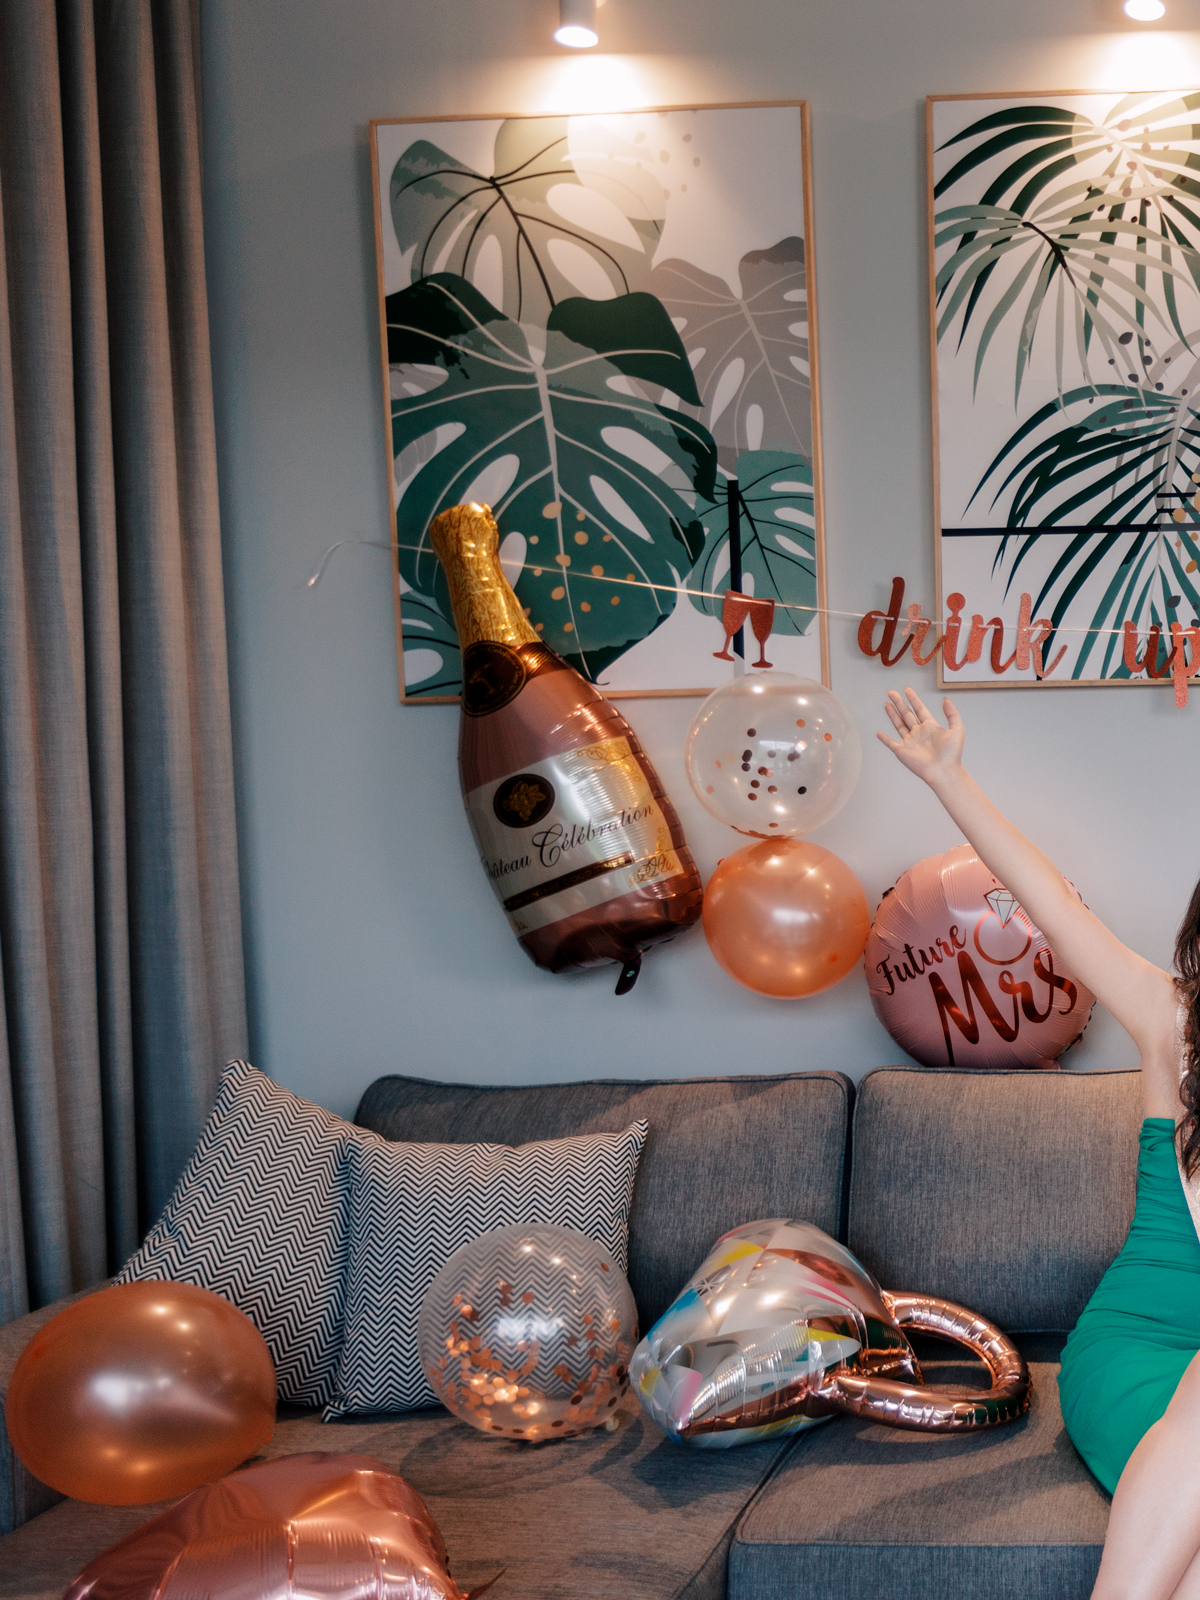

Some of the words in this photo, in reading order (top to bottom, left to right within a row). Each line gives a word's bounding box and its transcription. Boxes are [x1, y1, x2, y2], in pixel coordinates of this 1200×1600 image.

[857, 576, 1068, 680] drink
[481, 855, 533, 880] hâteau
[522, 880, 561, 903] VINTAGE
[563, 869, 593, 887] GOOD
[593, 856, 627, 874] TIMES
[876, 924, 967, 996] Future
[928, 947, 1079, 1068] Mrs
